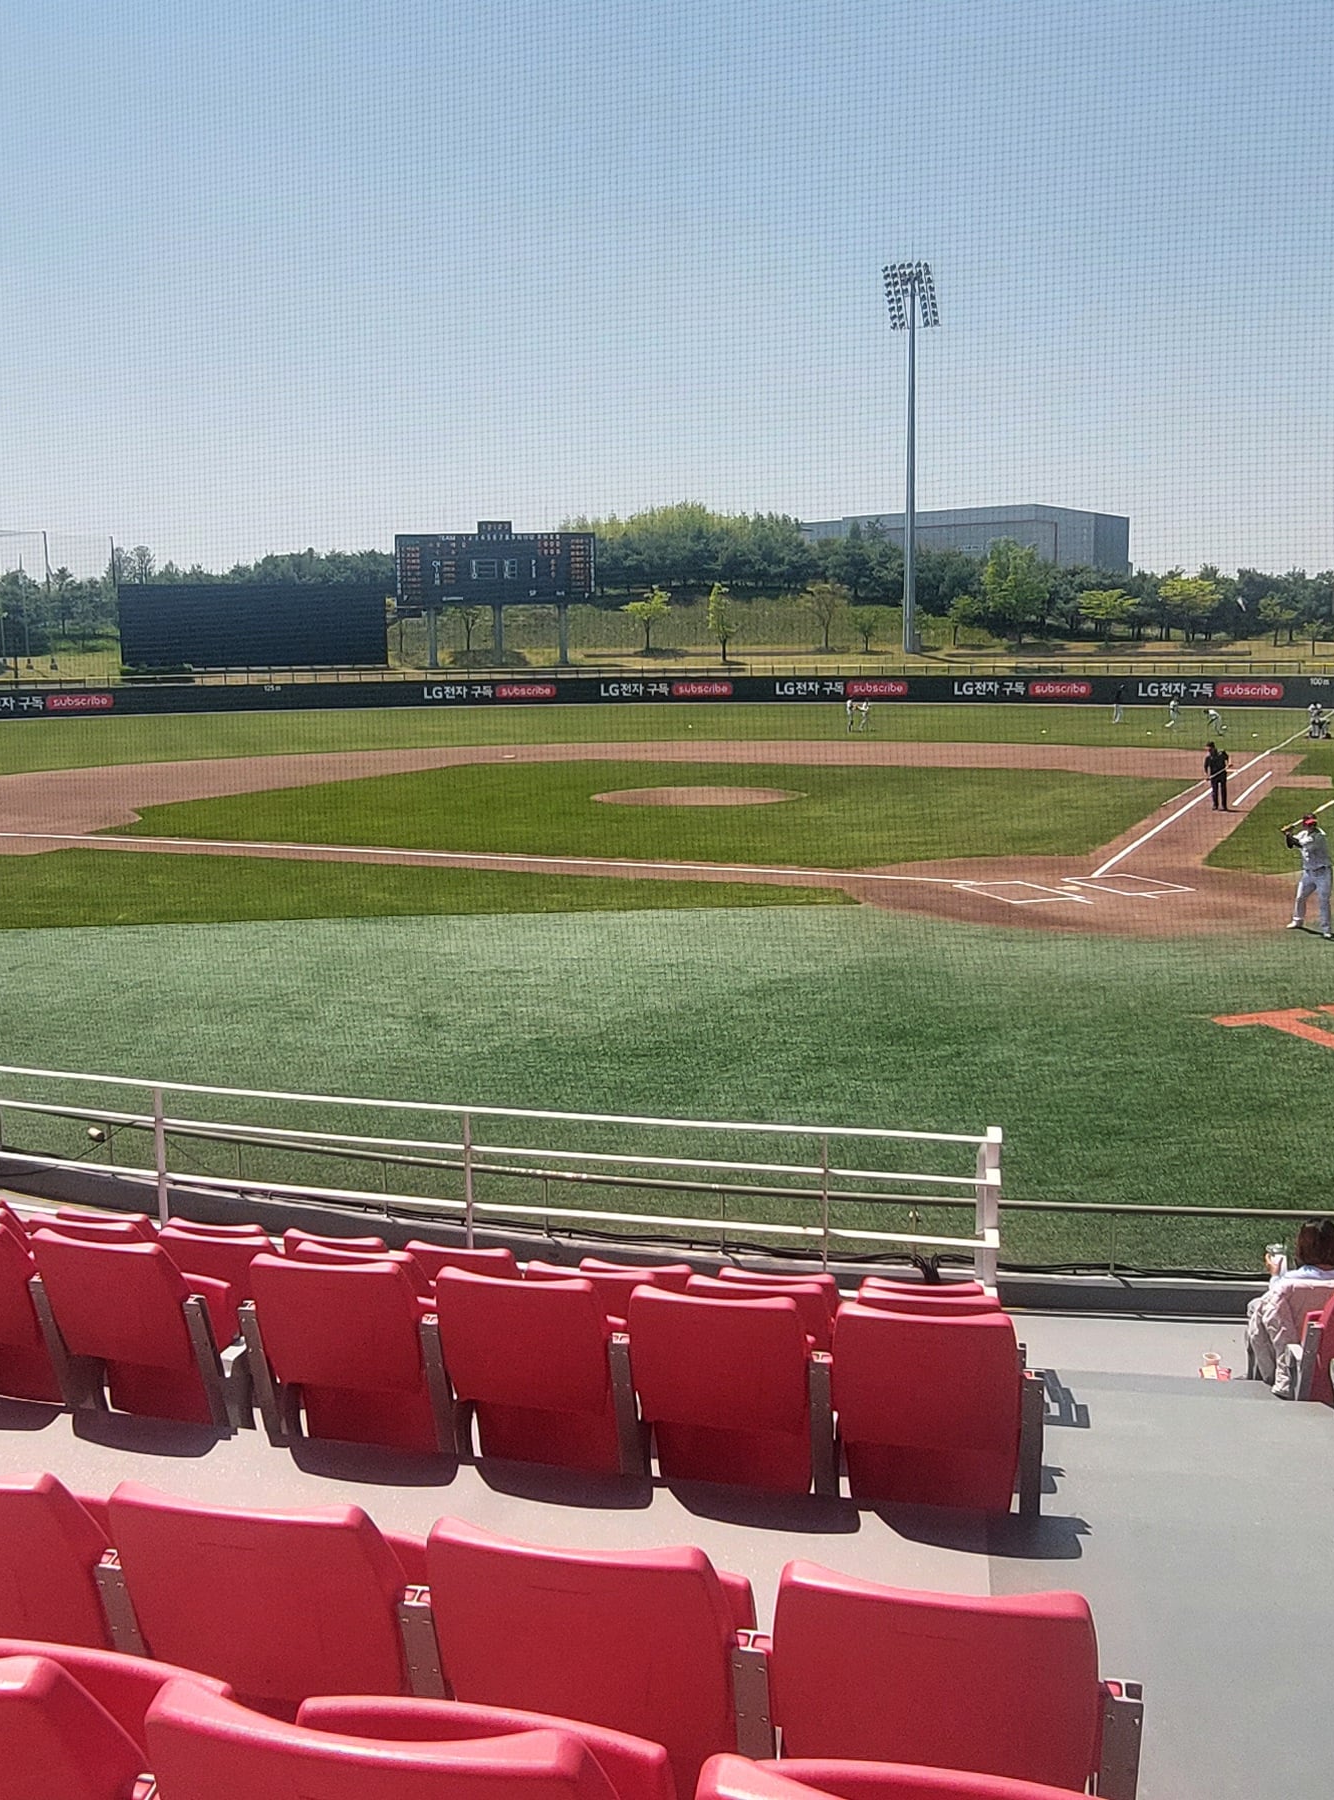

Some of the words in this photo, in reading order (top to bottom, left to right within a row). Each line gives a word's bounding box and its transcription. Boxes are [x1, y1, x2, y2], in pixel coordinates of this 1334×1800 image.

[501, 686, 551, 697] subscribe
[678, 683, 729, 693] subscribe
[853, 682, 904, 693] subscribe
[954, 681, 1000, 696] LG전자
[1034, 683, 1087, 694] subscribe
[1138, 682, 1186, 698] LG전자
[1222, 684, 1278, 696] subscribe
[53, 695, 108, 707] subscribe
